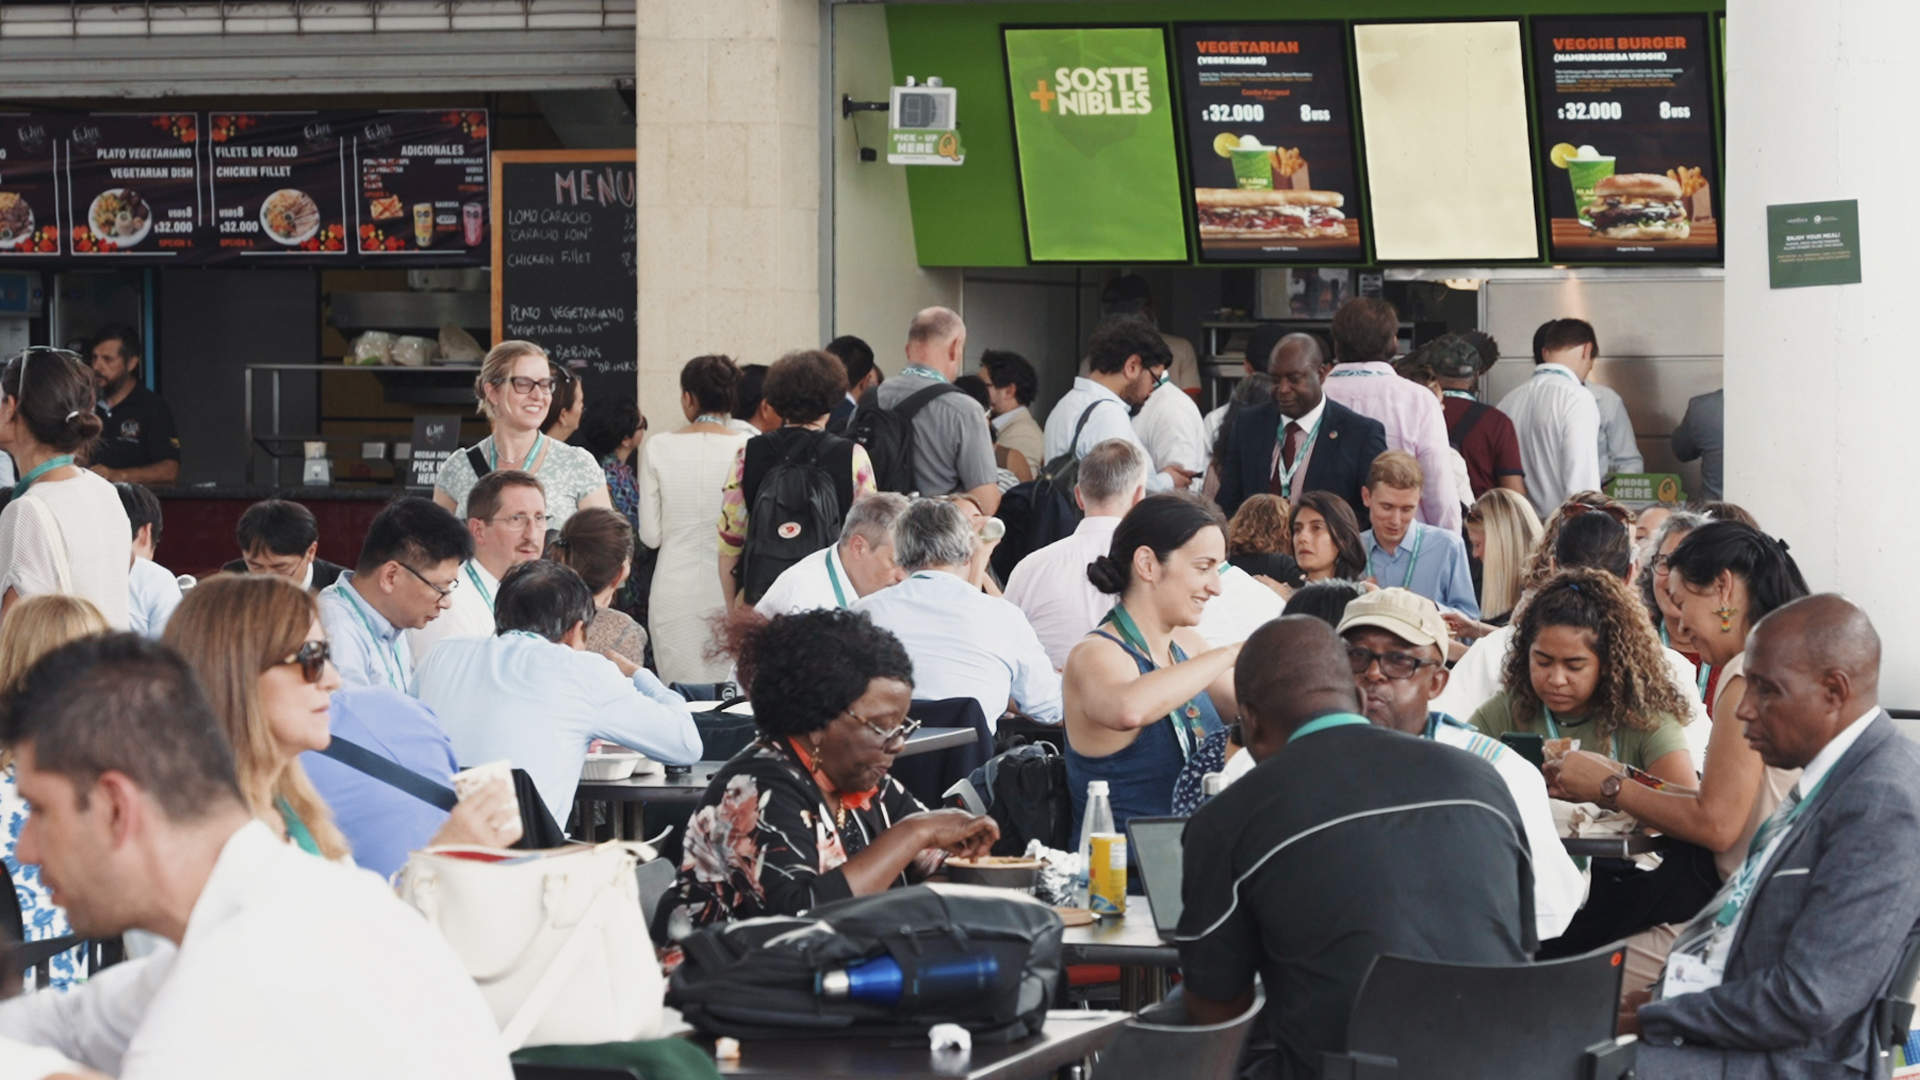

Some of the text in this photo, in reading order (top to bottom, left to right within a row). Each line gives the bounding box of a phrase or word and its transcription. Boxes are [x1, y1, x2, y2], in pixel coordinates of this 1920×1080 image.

[1196, 40, 1299, 54] VEGETARIAN
[1553, 36, 1686, 50] VEGGIE BURGER
[1197, 55, 1267, 65] (VEGETARIANO)
[1055, 67, 1149, 92] SOSTE
[1057, 91, 1152, 115] NIBLES
[893, 133, 916, 142] PICK
[924, 133, 938, 142] UP
[97, 148, 192, 159] PLATO VEGETARIANO
[215, 145, 298, 158] FILETE DE POLLO
[401, 145, 464, 156] ADICIONALES
[897, 142, 934, 153] HERE
[110, 167, 194, 179] VEGETARIAN DISH
[216, 166, 291, 178] CHICKEN FILLET
[555, 166, 636, 208] MENU
[508, 209, 538, 225] LOMO
[154, 221, 193, 233] $32.000
[219, 221, 259, 233] $32.000
[510, 304, 541, 322] PLATO
[550, 305, 624, 322] VEGETARIANO
[412, 460, 435, 473] PICK
[417, 473, 436, 485] HER
[1616, 478, 1650, 487] ORDER
[1613, 487, 1652, 498] HERE
